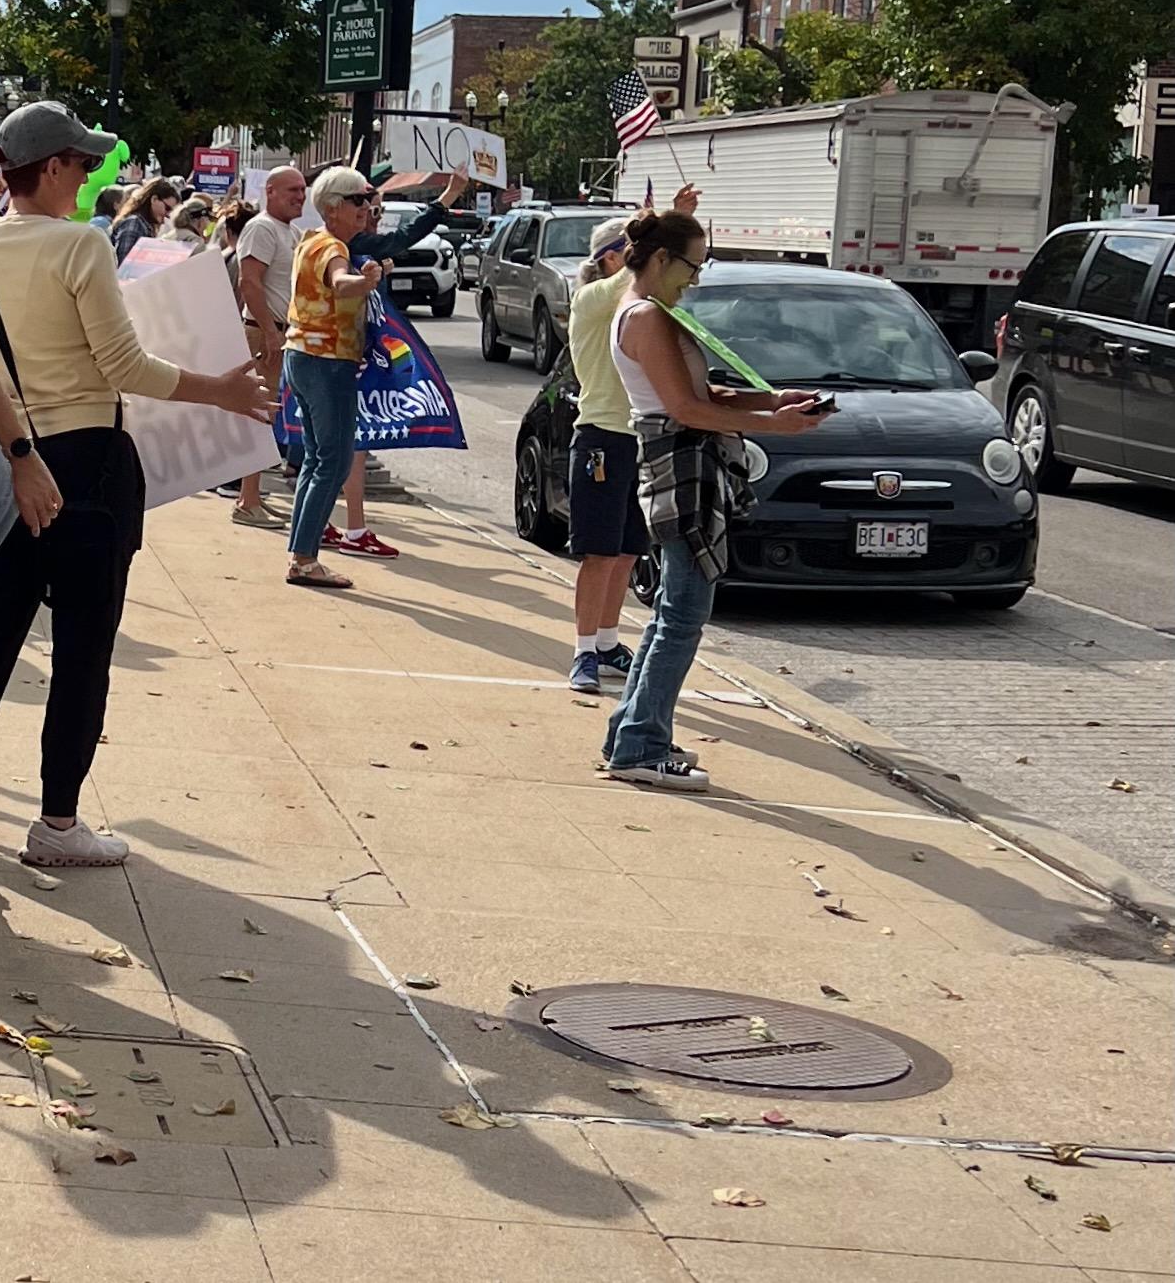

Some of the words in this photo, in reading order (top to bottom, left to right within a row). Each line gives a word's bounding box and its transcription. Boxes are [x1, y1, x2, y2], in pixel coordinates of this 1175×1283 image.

[336, 17, 374, 32] 2-HOUR
[333, 27, 376, 42] PARKING
[649, 41, 672, 55] THE
[413, 124, 471, 171] NO
[895, 527, 927, 547] E3C
